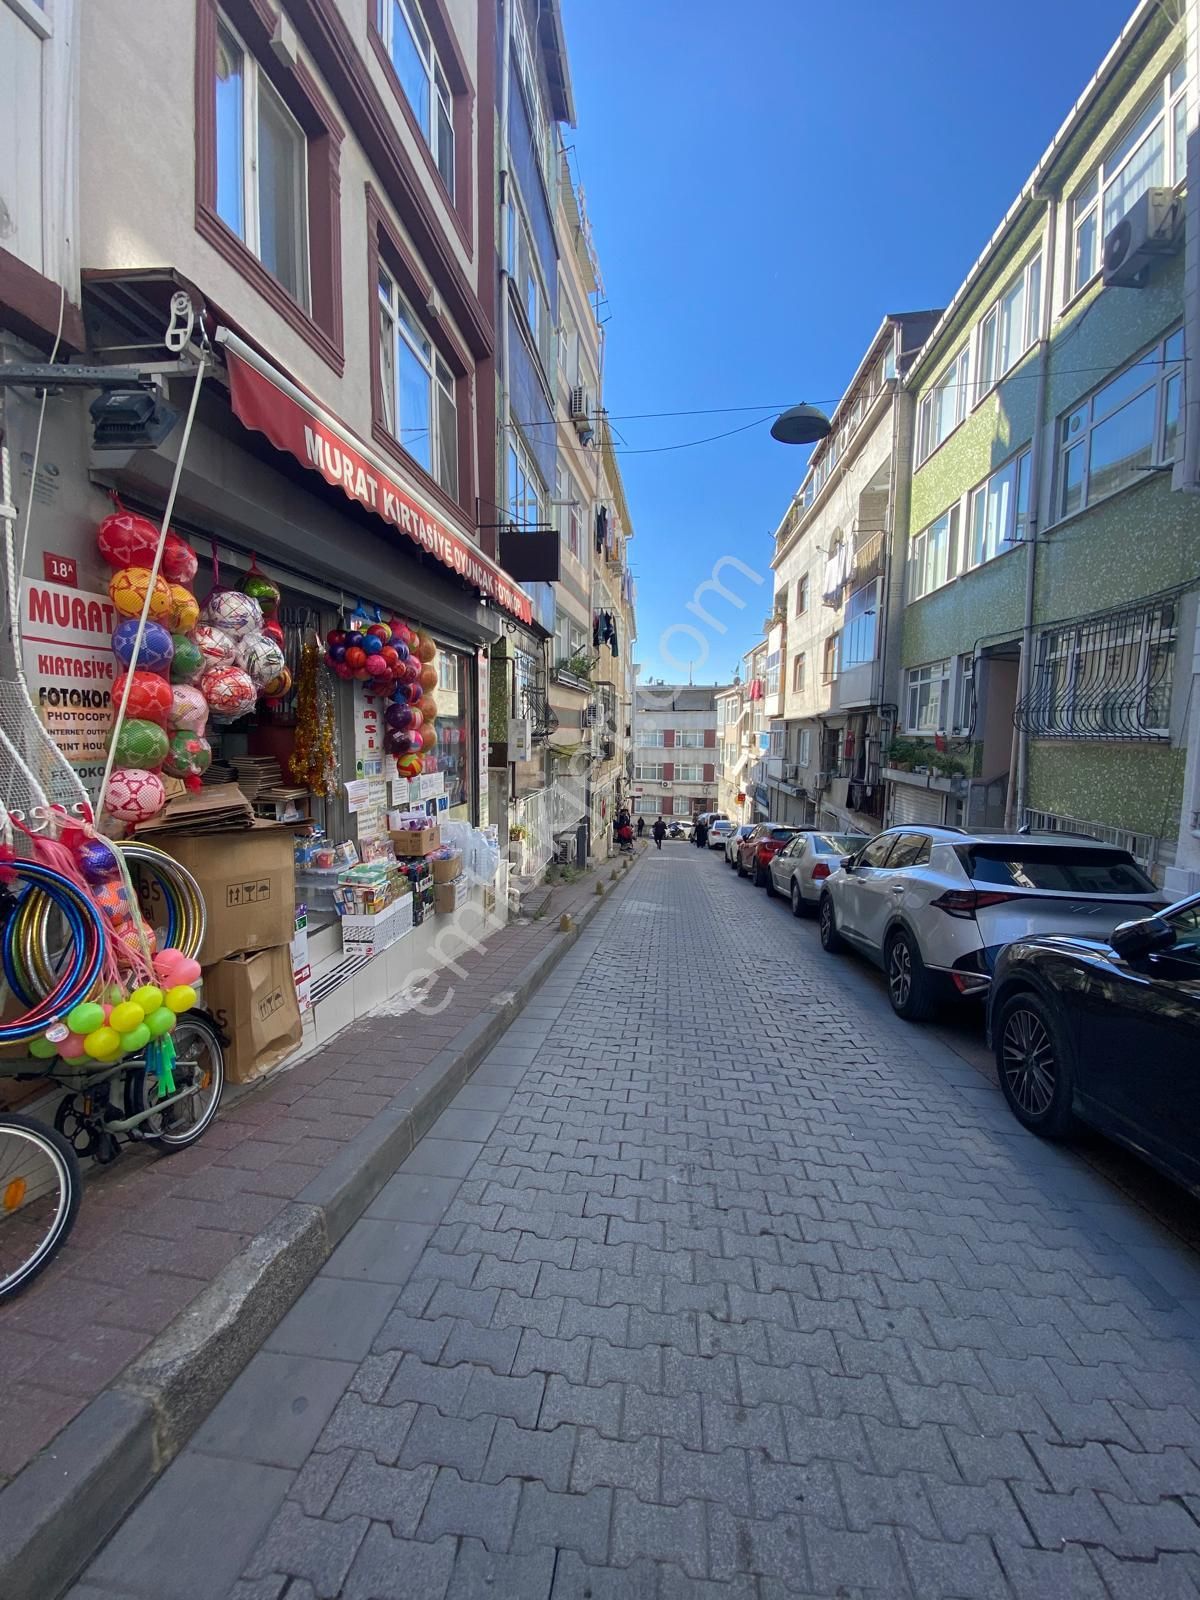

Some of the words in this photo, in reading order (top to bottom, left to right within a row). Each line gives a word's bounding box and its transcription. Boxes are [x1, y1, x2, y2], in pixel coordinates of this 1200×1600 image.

[304, 424, 377, 508] MURAT
[382, 488, 454, 563] KIRTASİYE
[453, 546, 494, 595] OYUNCAK
[29, 587, 114, 635] MURAT
[38, 654, 113, 681] KIRTASİYE
[47, 711, 112, 722] PHOTOCOPY
